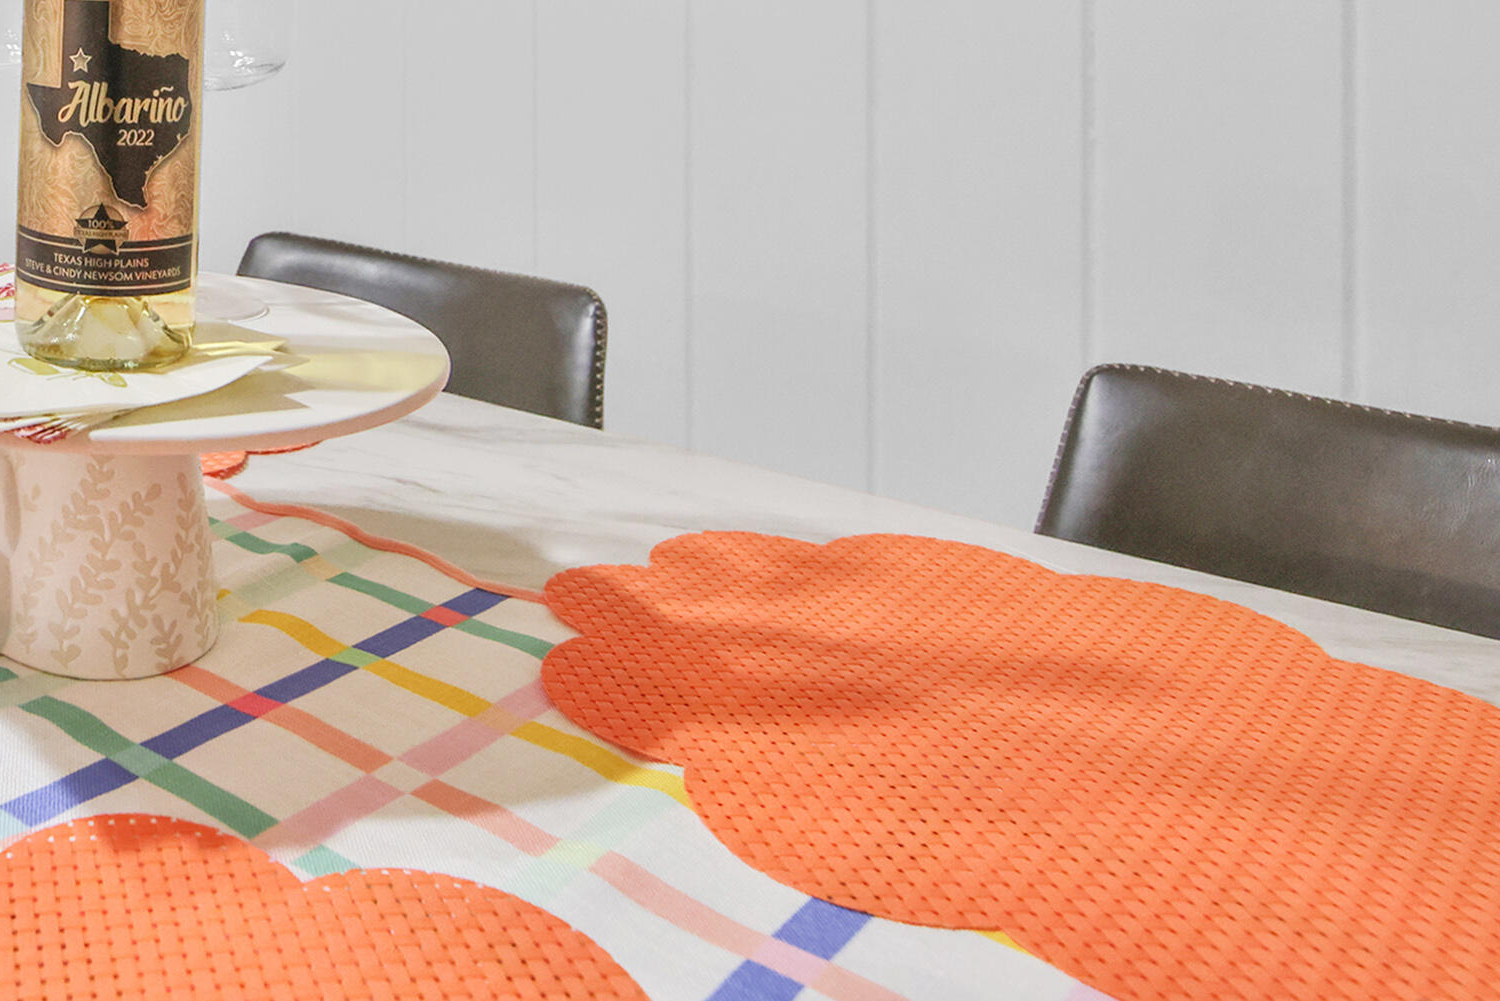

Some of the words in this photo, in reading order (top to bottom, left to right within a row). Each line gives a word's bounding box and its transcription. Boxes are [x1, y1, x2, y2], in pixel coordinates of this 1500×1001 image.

[58, 80, 188, 127] Albariño
[117, 129, 155, 146] 2022
[87, 219, 115, 230] 100%
[54, 253, 83, 266] TEXAS
[84, 257, 112, 268] HIGH
[114, 258, 149, 268] PLAINS
[25, 258, 45, 272] STEVE
[46, 265, 51, 274] &
[53, 265, 83, 279] CINDY
[83, 270, 133, 281] NEWSOM
[135, 266, 181, 280] VINEYARDS
